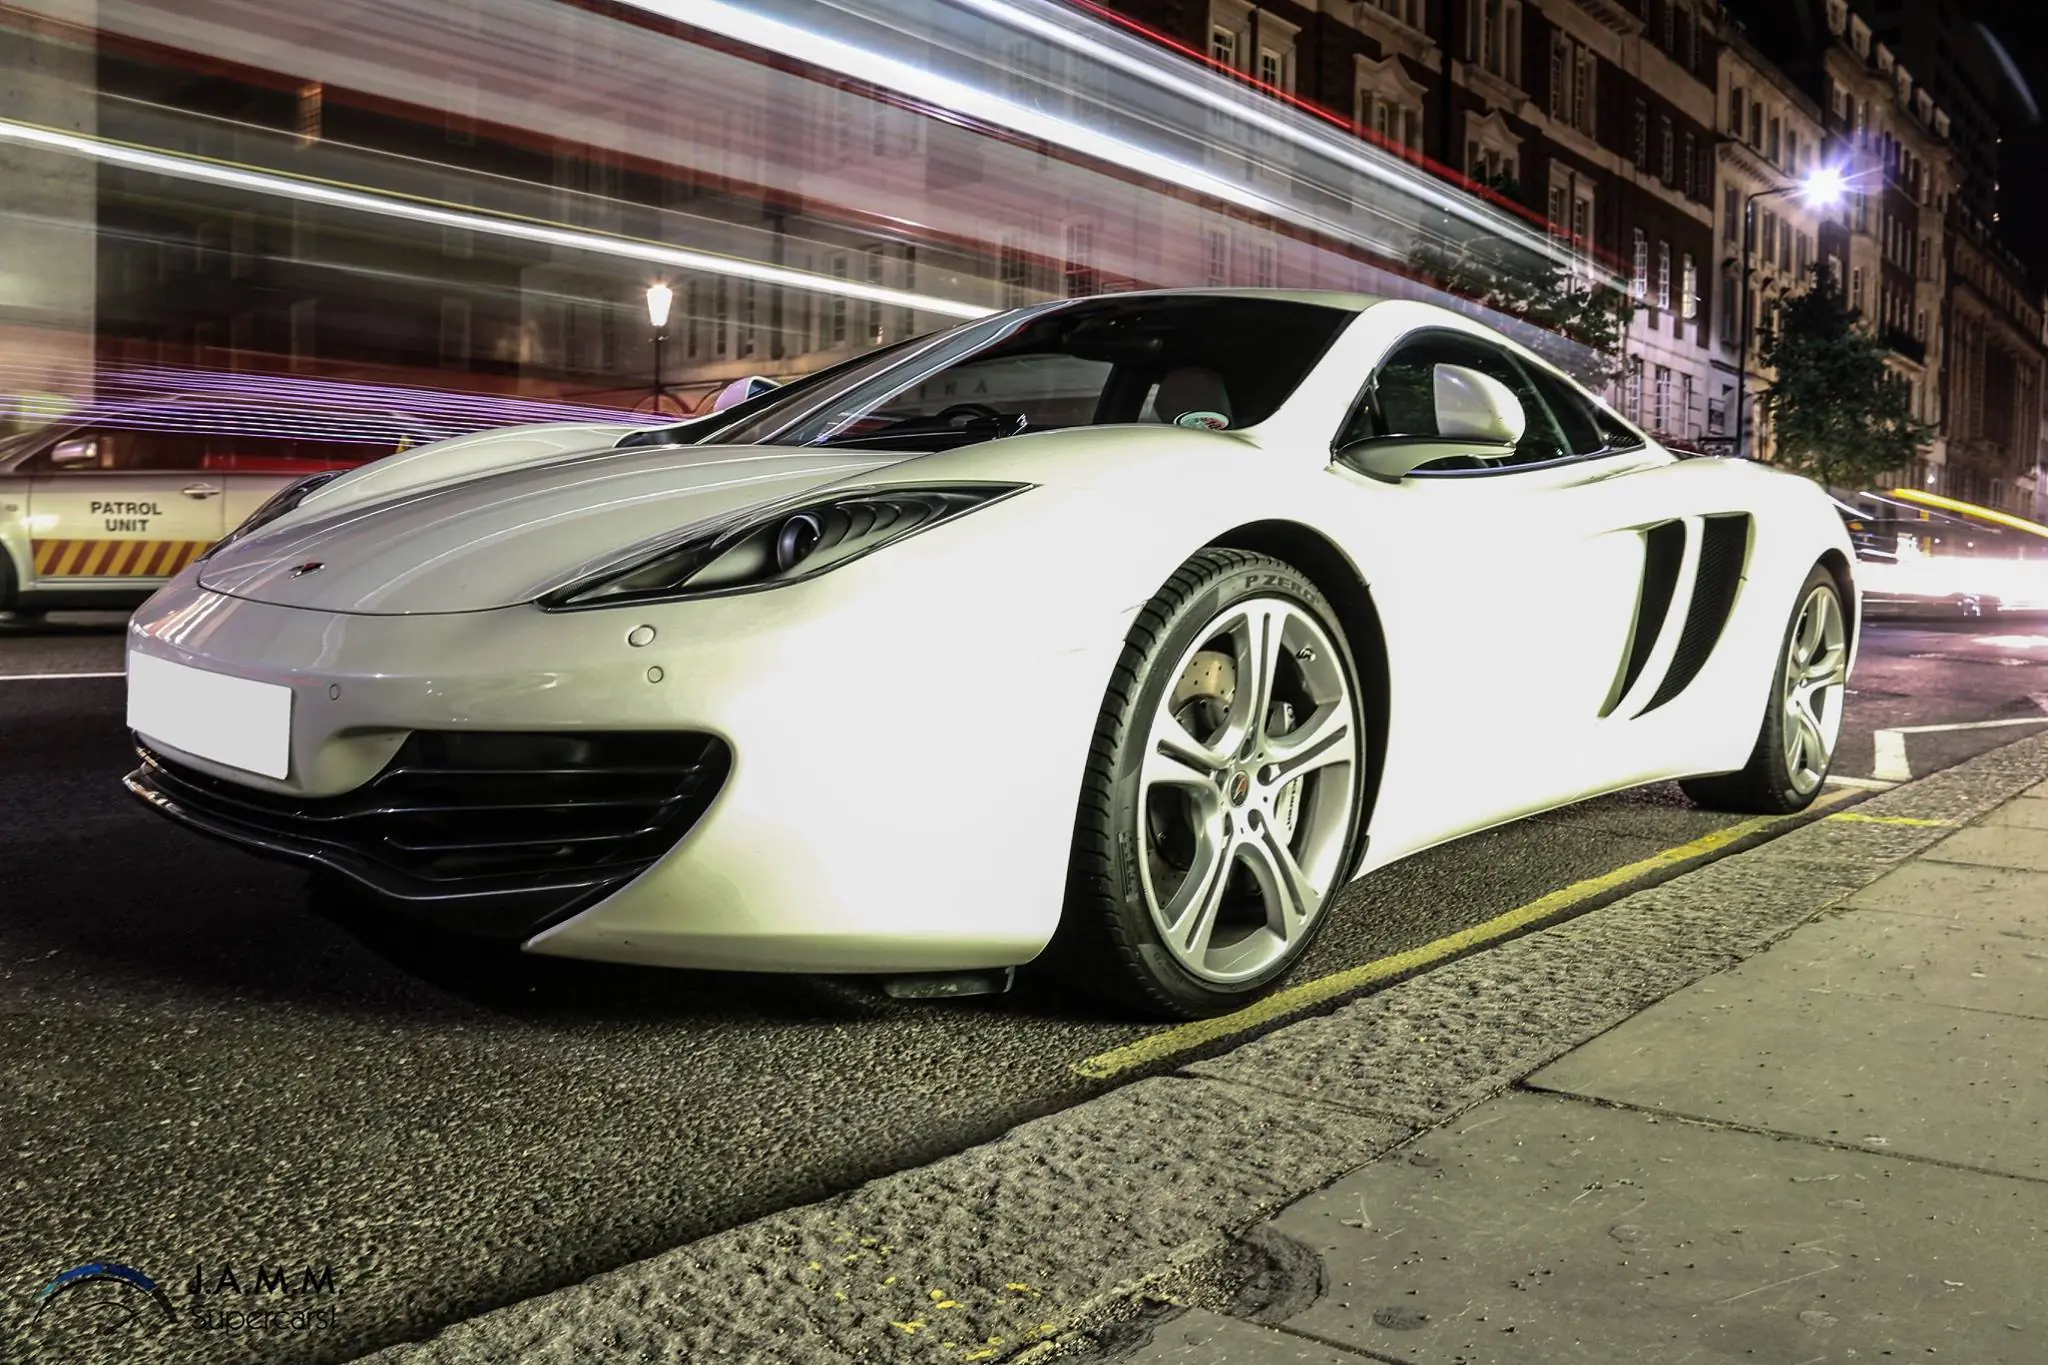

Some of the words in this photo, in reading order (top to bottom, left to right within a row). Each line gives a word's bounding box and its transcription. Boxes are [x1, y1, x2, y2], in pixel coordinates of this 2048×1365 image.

[91, 501, 163, 515] PATROL
[105, 519, 149, 532] UNIT
[1244, 575, 1259, 589] P
[1263, 574, 1317, 602] ZERO
